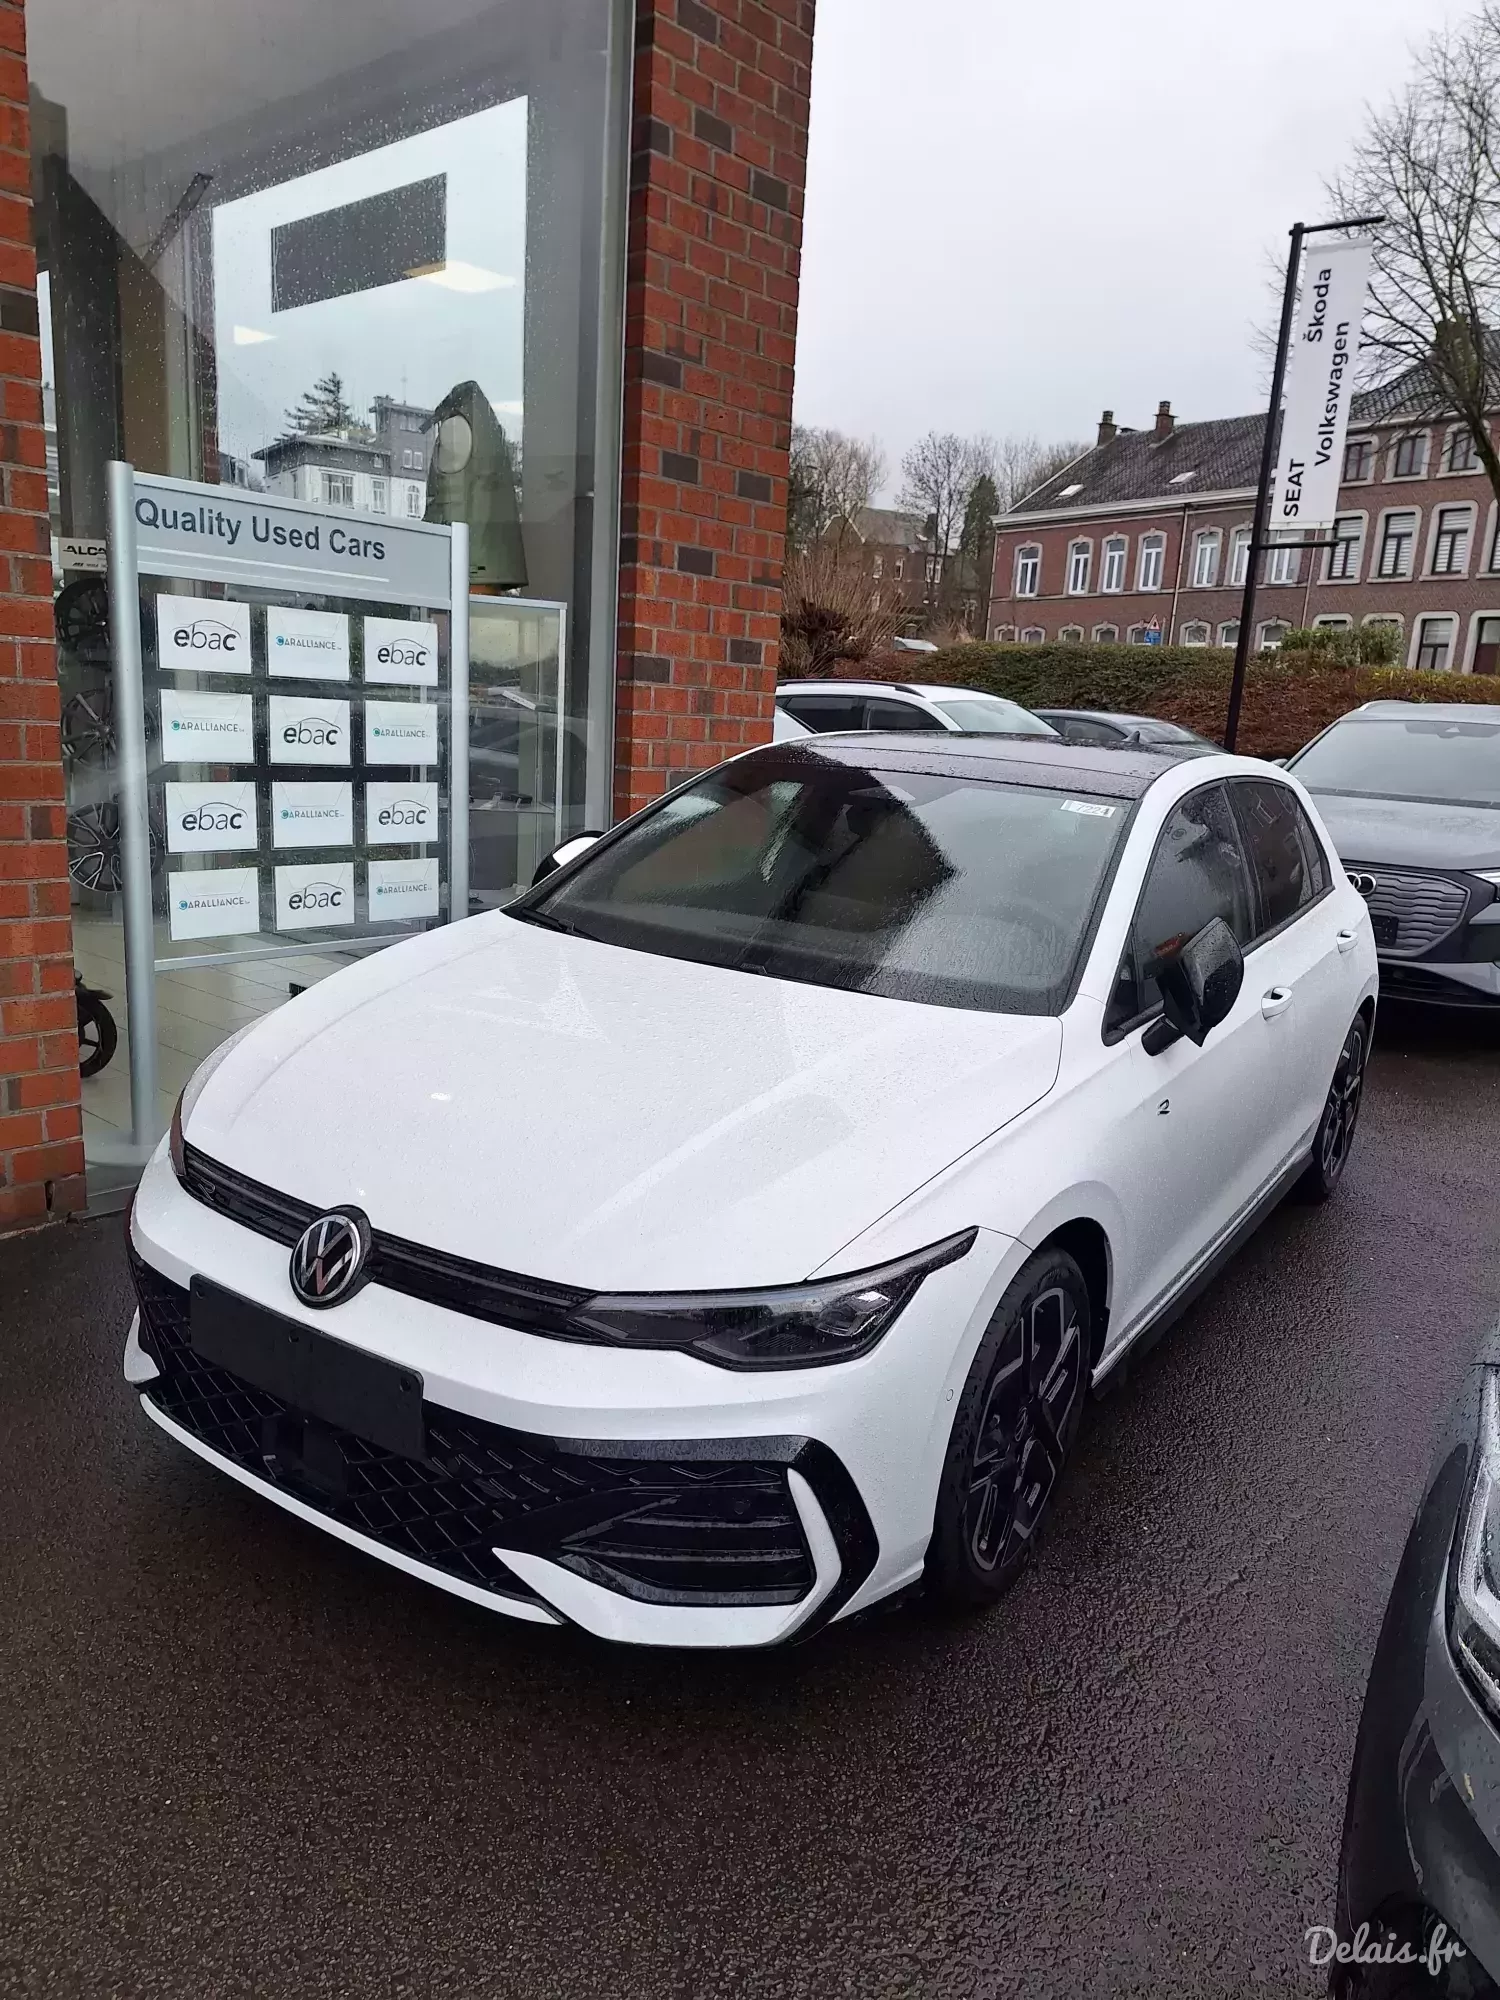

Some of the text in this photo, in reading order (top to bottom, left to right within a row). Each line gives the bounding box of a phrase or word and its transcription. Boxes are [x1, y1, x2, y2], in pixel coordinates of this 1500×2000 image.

[1302, 267, 1332, 342] Škoda
[1315, 321, 1350, 467] Volkswagen
[1283, 458, 1305, 517] SEAT
[135, 497, 386, 560] Quality Used Cars
[173, 624, 237, 651] ebac
[377, 643, 427, 666] ebac
[283, 721, 338, 745] ebac
[182, 807, 243, 831] ebac
[378, 804, 427, 825] ebac
[288, 887, 342, 910] ebac
